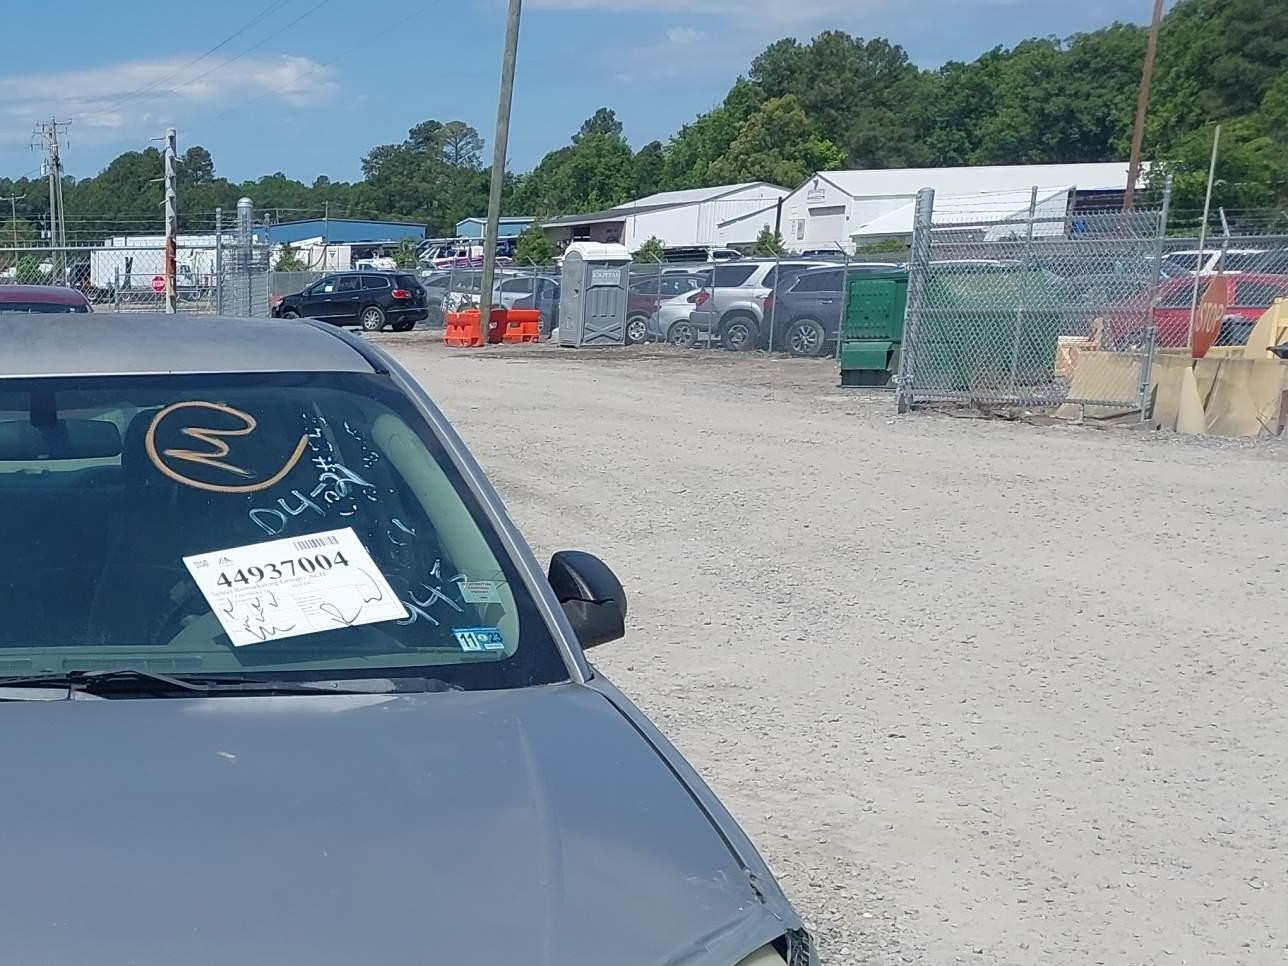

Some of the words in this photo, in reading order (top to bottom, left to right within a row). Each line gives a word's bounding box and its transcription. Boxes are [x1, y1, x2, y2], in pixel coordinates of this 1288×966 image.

[1195, 303, 1225, 332] STOP
[216, 551, 350, 588] 44937004
[459, 633, 478, 650] 11
